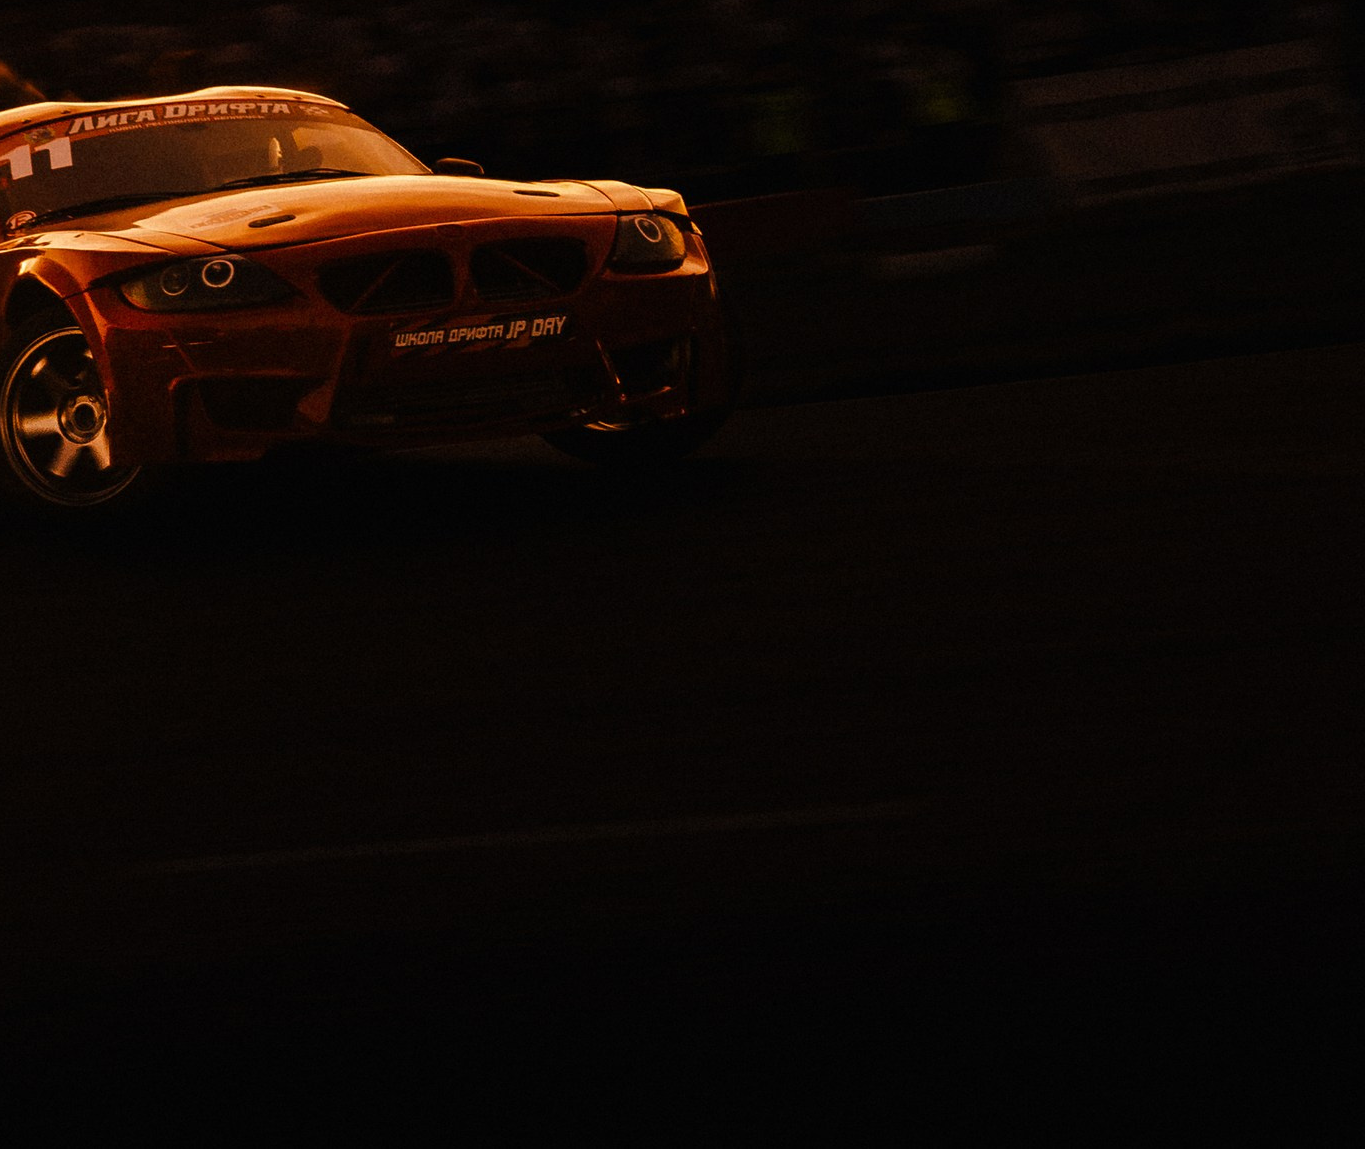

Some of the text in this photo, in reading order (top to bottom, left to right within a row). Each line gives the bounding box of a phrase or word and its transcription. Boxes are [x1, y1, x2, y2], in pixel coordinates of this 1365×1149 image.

[395, 330, 444, 347] ШКОЛА
[506, 320, 527, 340] JP
[531, 316, 567, 337] DAY
